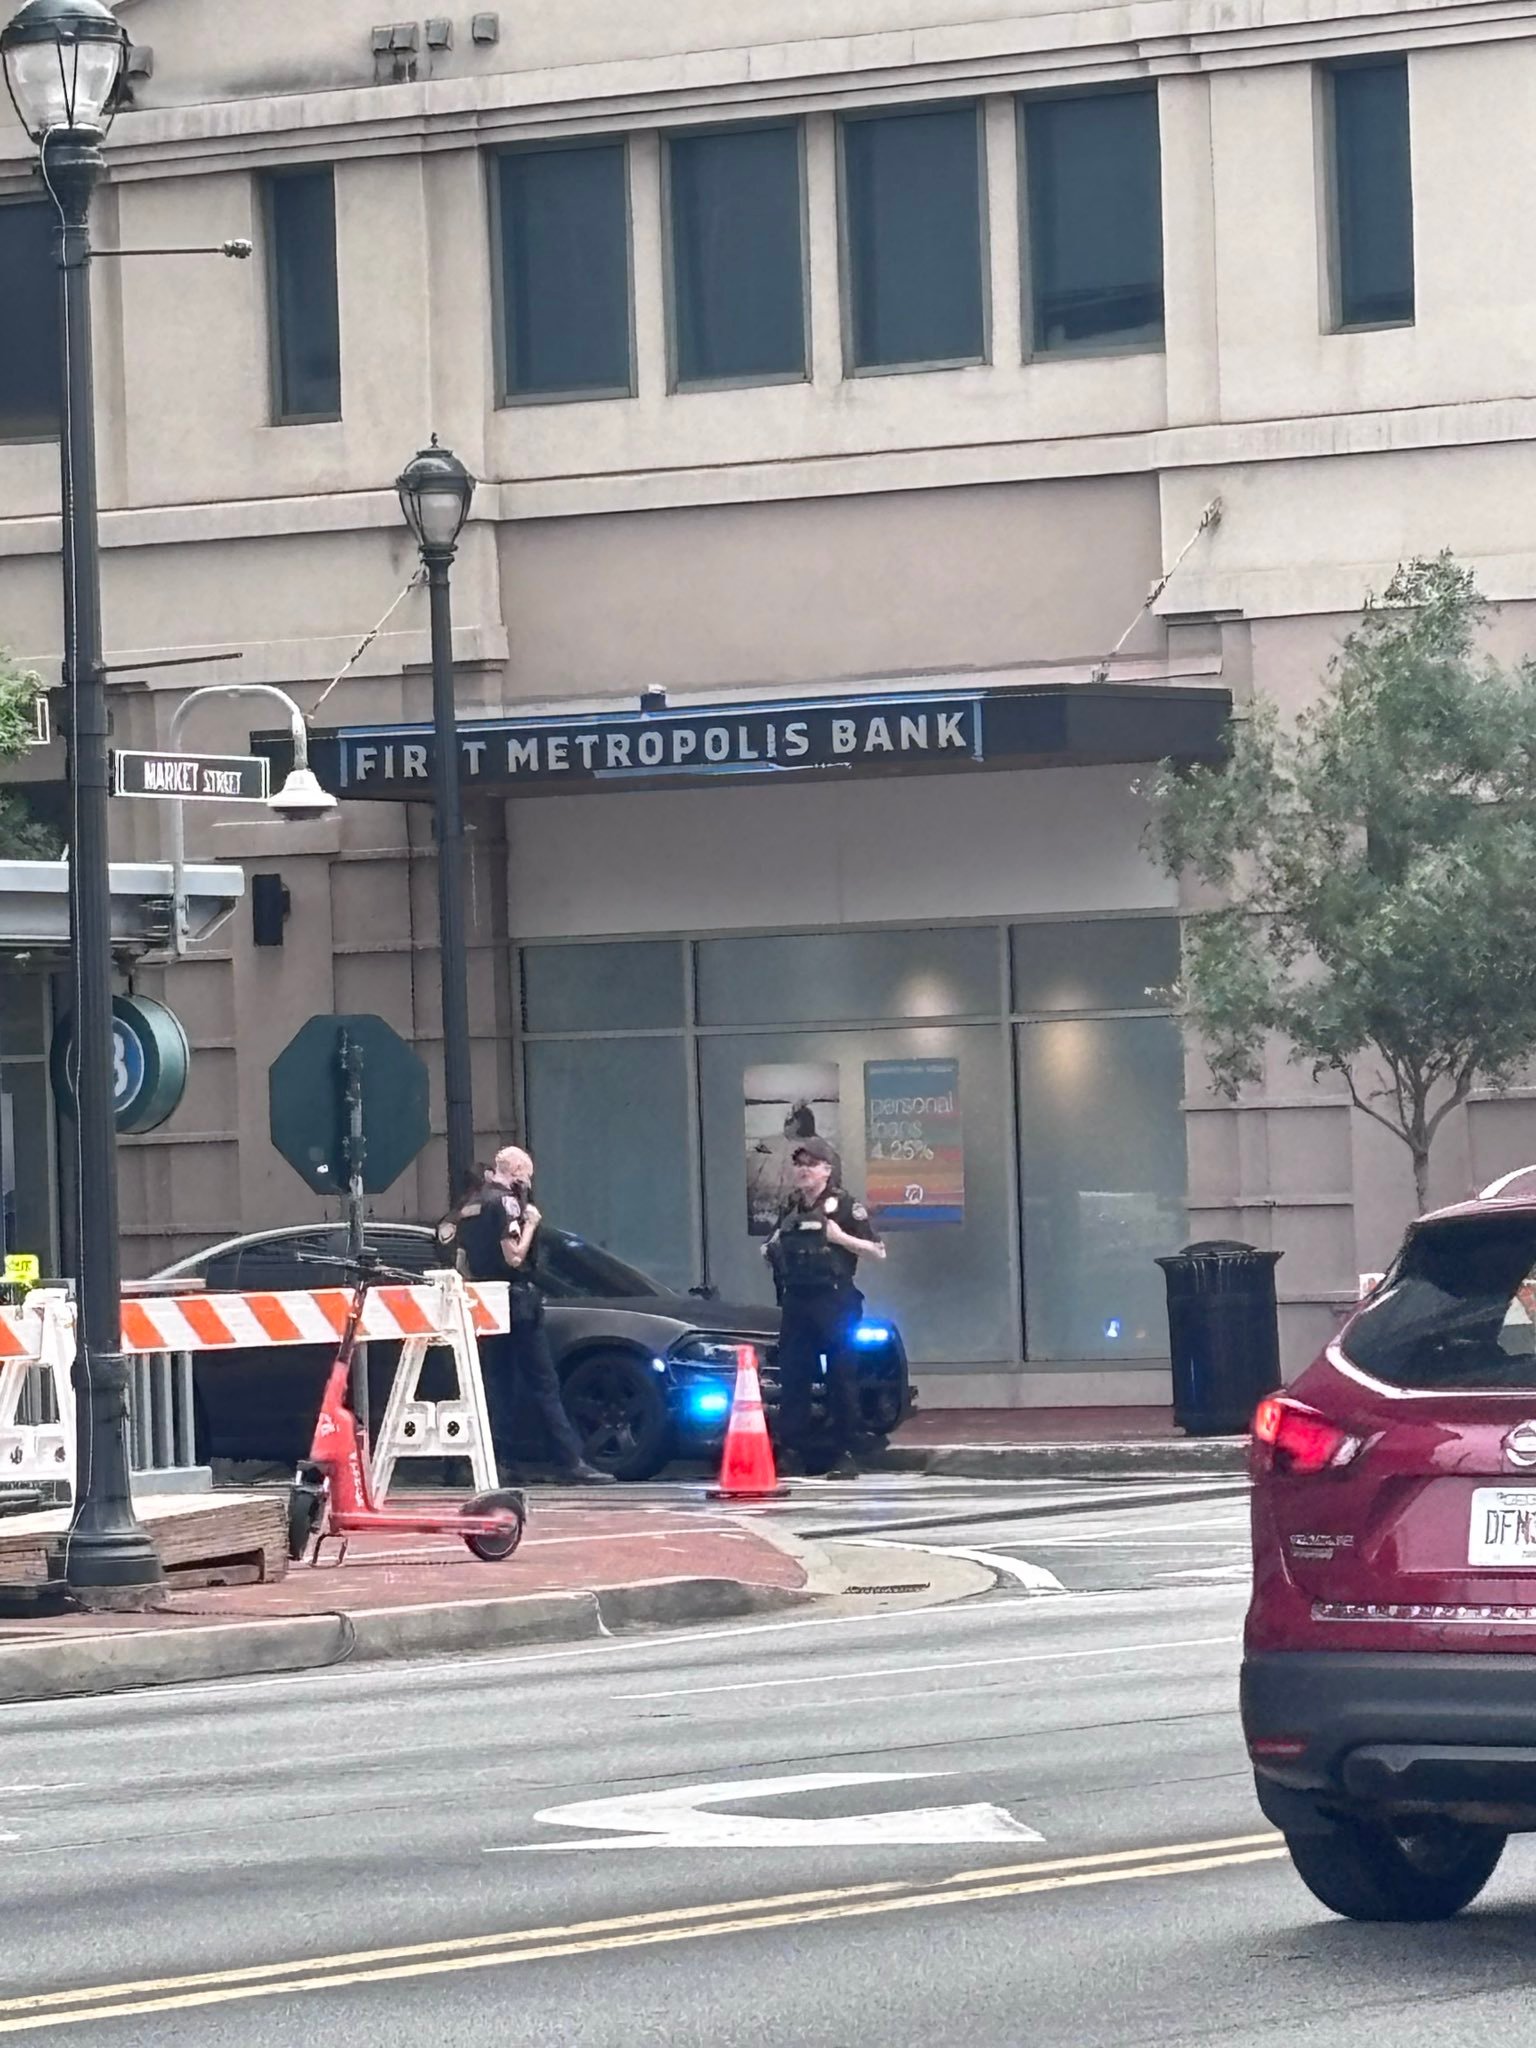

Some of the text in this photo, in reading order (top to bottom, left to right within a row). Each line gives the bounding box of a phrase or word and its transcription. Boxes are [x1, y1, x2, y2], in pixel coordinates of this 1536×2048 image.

[356, 711, 967, 780] FIRT METROPOLIS BANK
[144, 761, 199, 791] MARKET
[870, 1090, 954, 1123] personal
